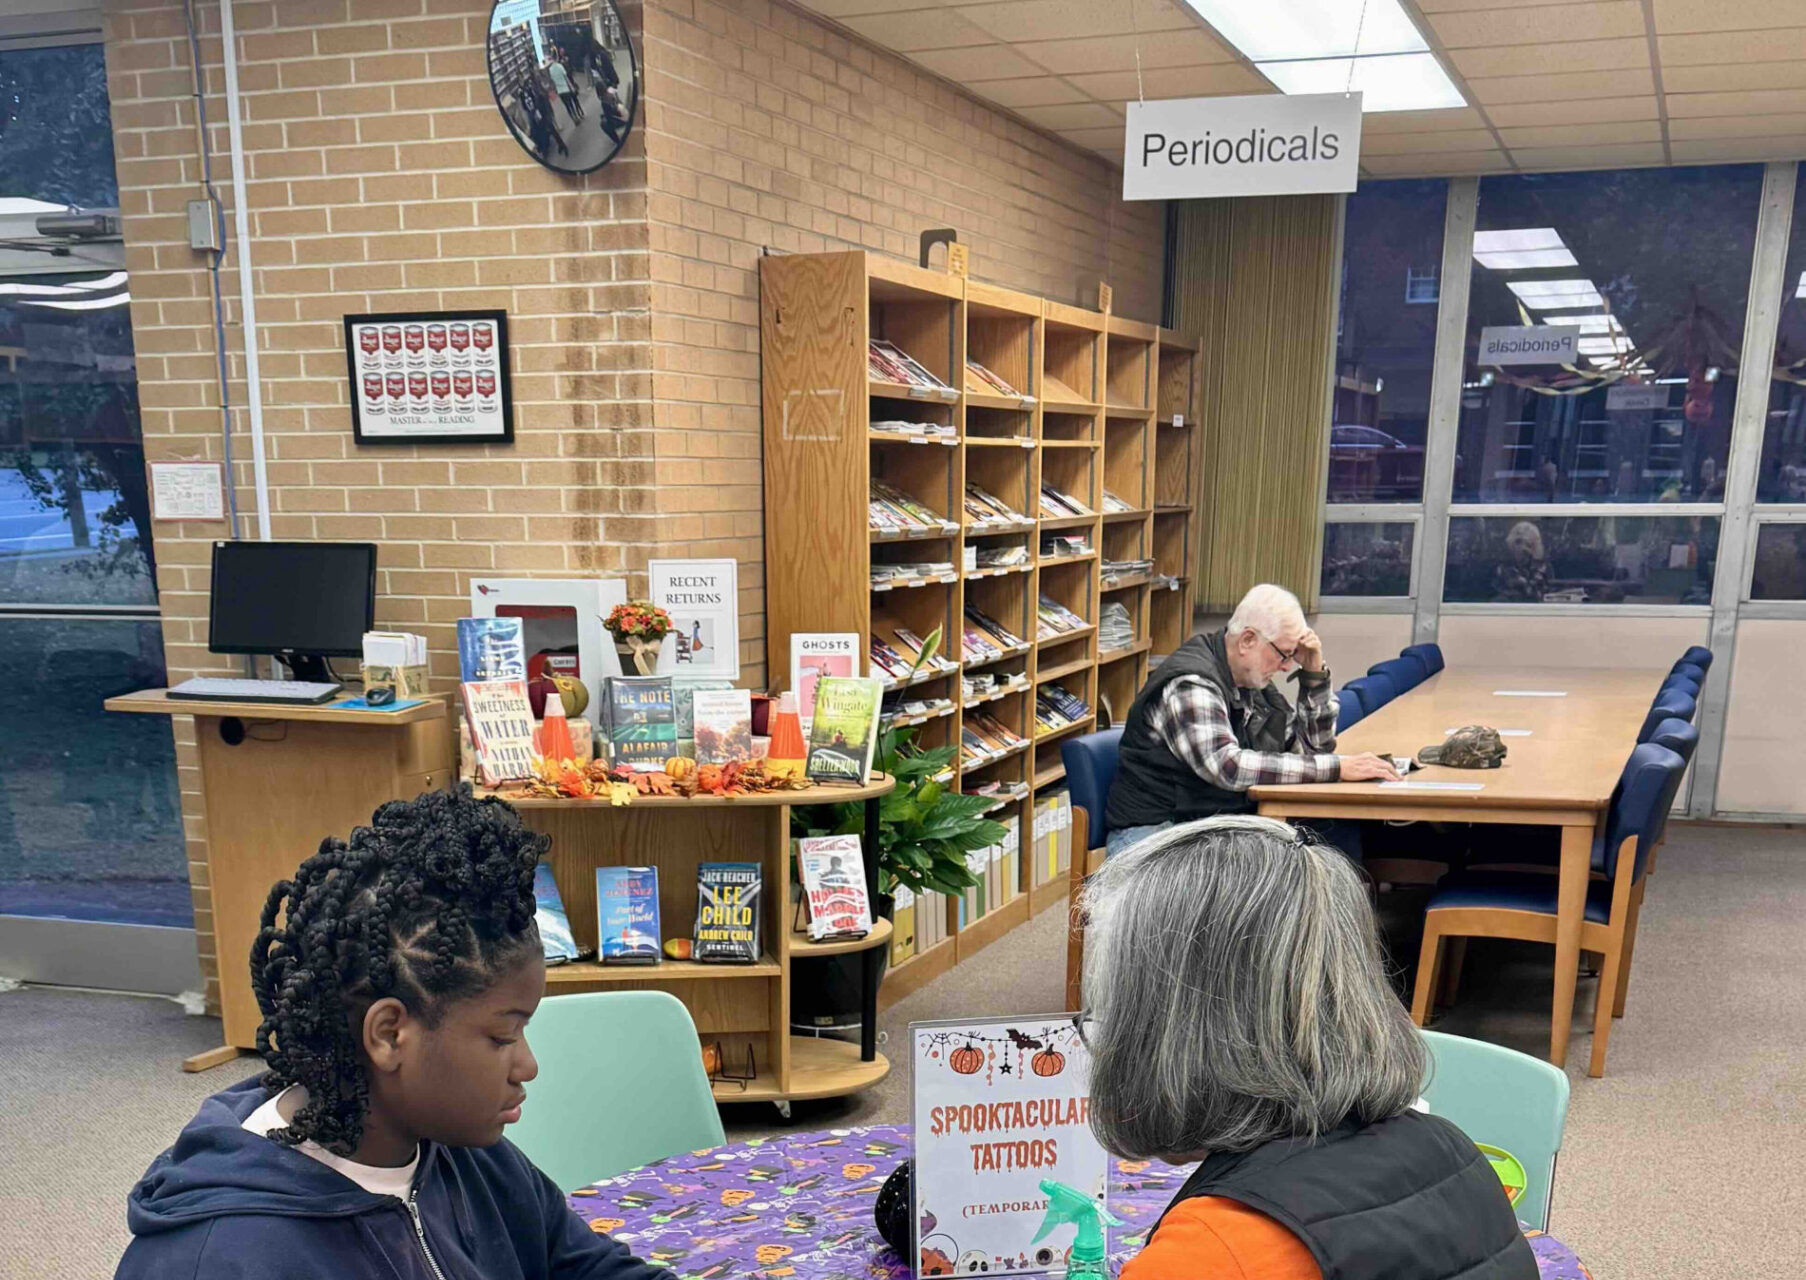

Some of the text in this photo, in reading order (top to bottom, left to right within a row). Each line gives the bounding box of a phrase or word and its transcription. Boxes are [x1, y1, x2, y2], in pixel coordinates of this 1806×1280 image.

[1142, 125, 1340, 168] Periodicals
[389, 415, 421, 424] MASTER
[438, 415, 475, 424] READING
[669, 576, 717, 587] RECENT
[666, 593, 722, 604] RETURNS
[802, 640, 850, 650] GHOSTS
[640, 689, 672, 703] NOTE
[473, 699, 527, 714] SWEETNESS
[821, 696, 868, 713] Wingate
[480, 718, 531, 740] WATER
[702, 872, 756, 883] JACK REACHER
[713, 886, 743, 905] LEE
[702, 906, 752, 926] CHILD
[699, 929, 753, 940] ANDREW CHILD
[930, 1096, 1091, 1138] SPOOKTACULAR
[970, 1138, 1058, 1175] TATTOOS
[962, 1200, 1050, 1218] (TEMPORAR
